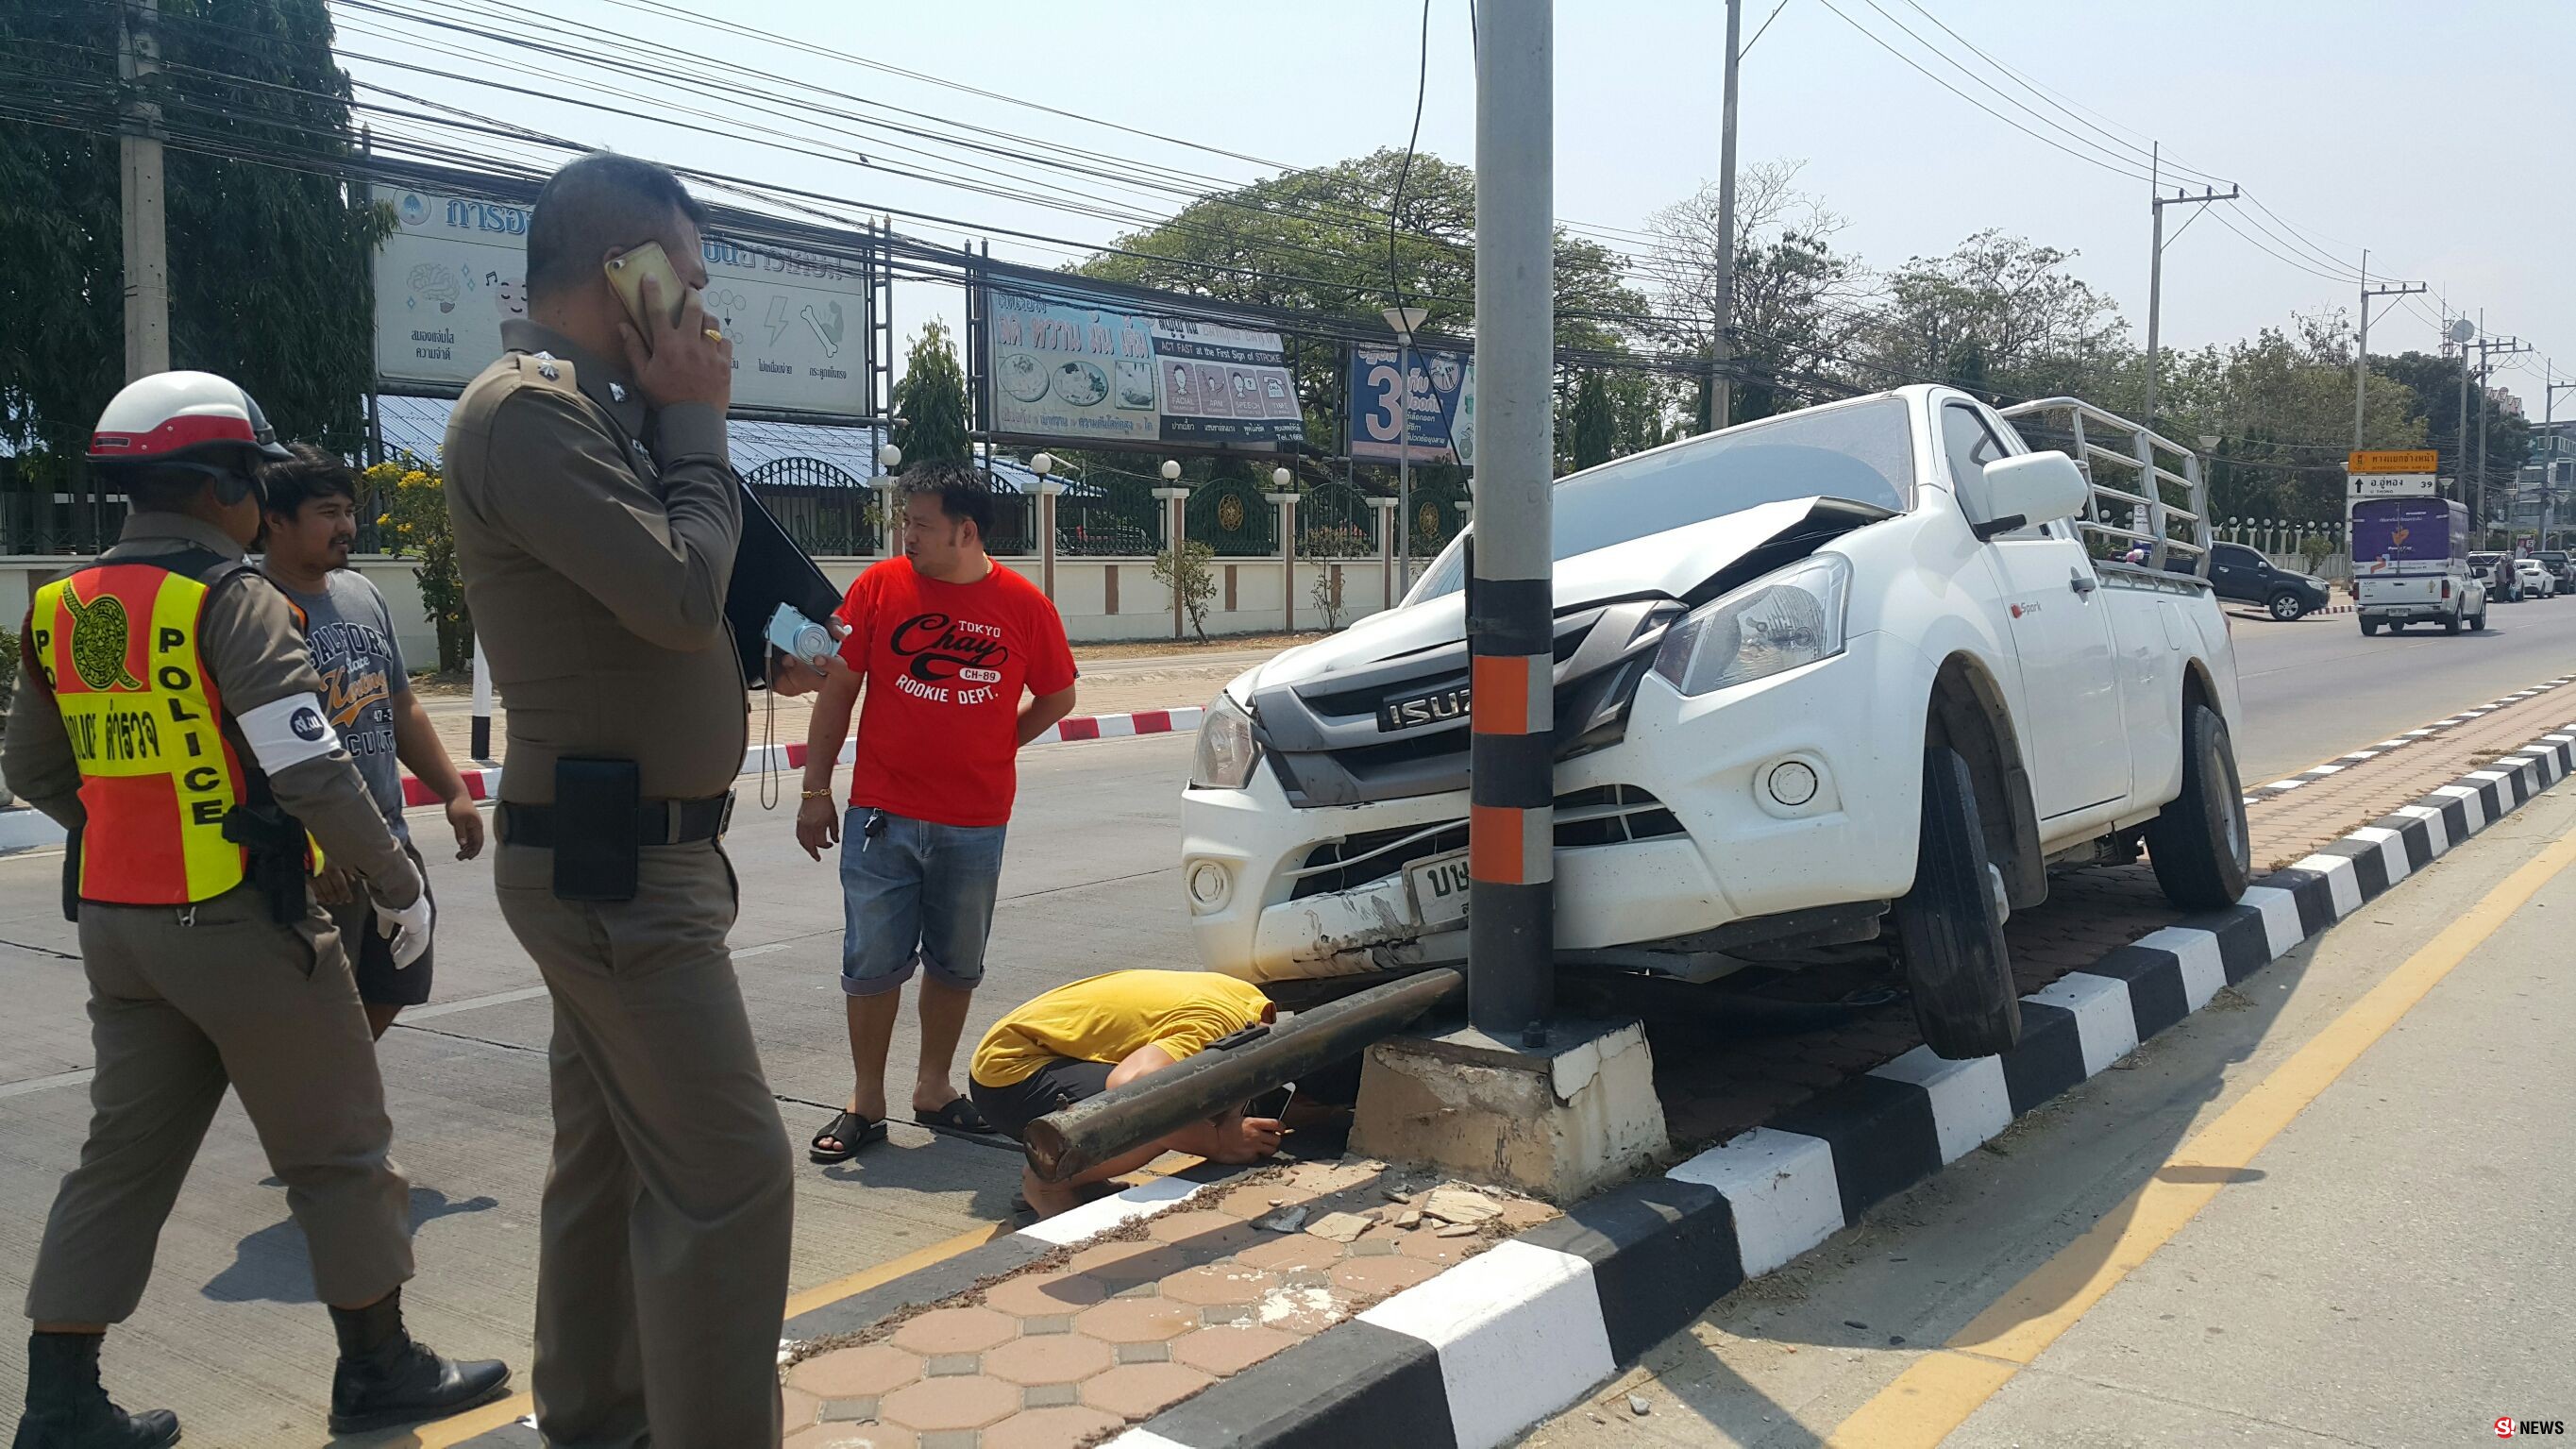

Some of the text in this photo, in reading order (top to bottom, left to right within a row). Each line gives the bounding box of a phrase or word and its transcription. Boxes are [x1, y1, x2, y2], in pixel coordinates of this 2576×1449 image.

[411, 328, 454, 344] สมองแจ่มใส
[1031, 315, 1082, 352] หวาน
[415, 346, 451, 360] ความจำดี
[1161, 341, 1174, 352] ACT
[1177, 343, 1193, 354] FAST
[1196, 346, 1203, 355] at
[1366, 365, 1403, 441] 3
[2021, 601, 2042, 615] Spark
[958, 619, 1002, 638] TOKYO
[965, 669, 997, 682] CH-89
[896, 673, 999, 704] ROOKIE DEPT.
[1389, 689, 1471, 726] ISU
[106, 699, 160, 761] ตำรวจ
[159, 627, 225, 825] POLICE
